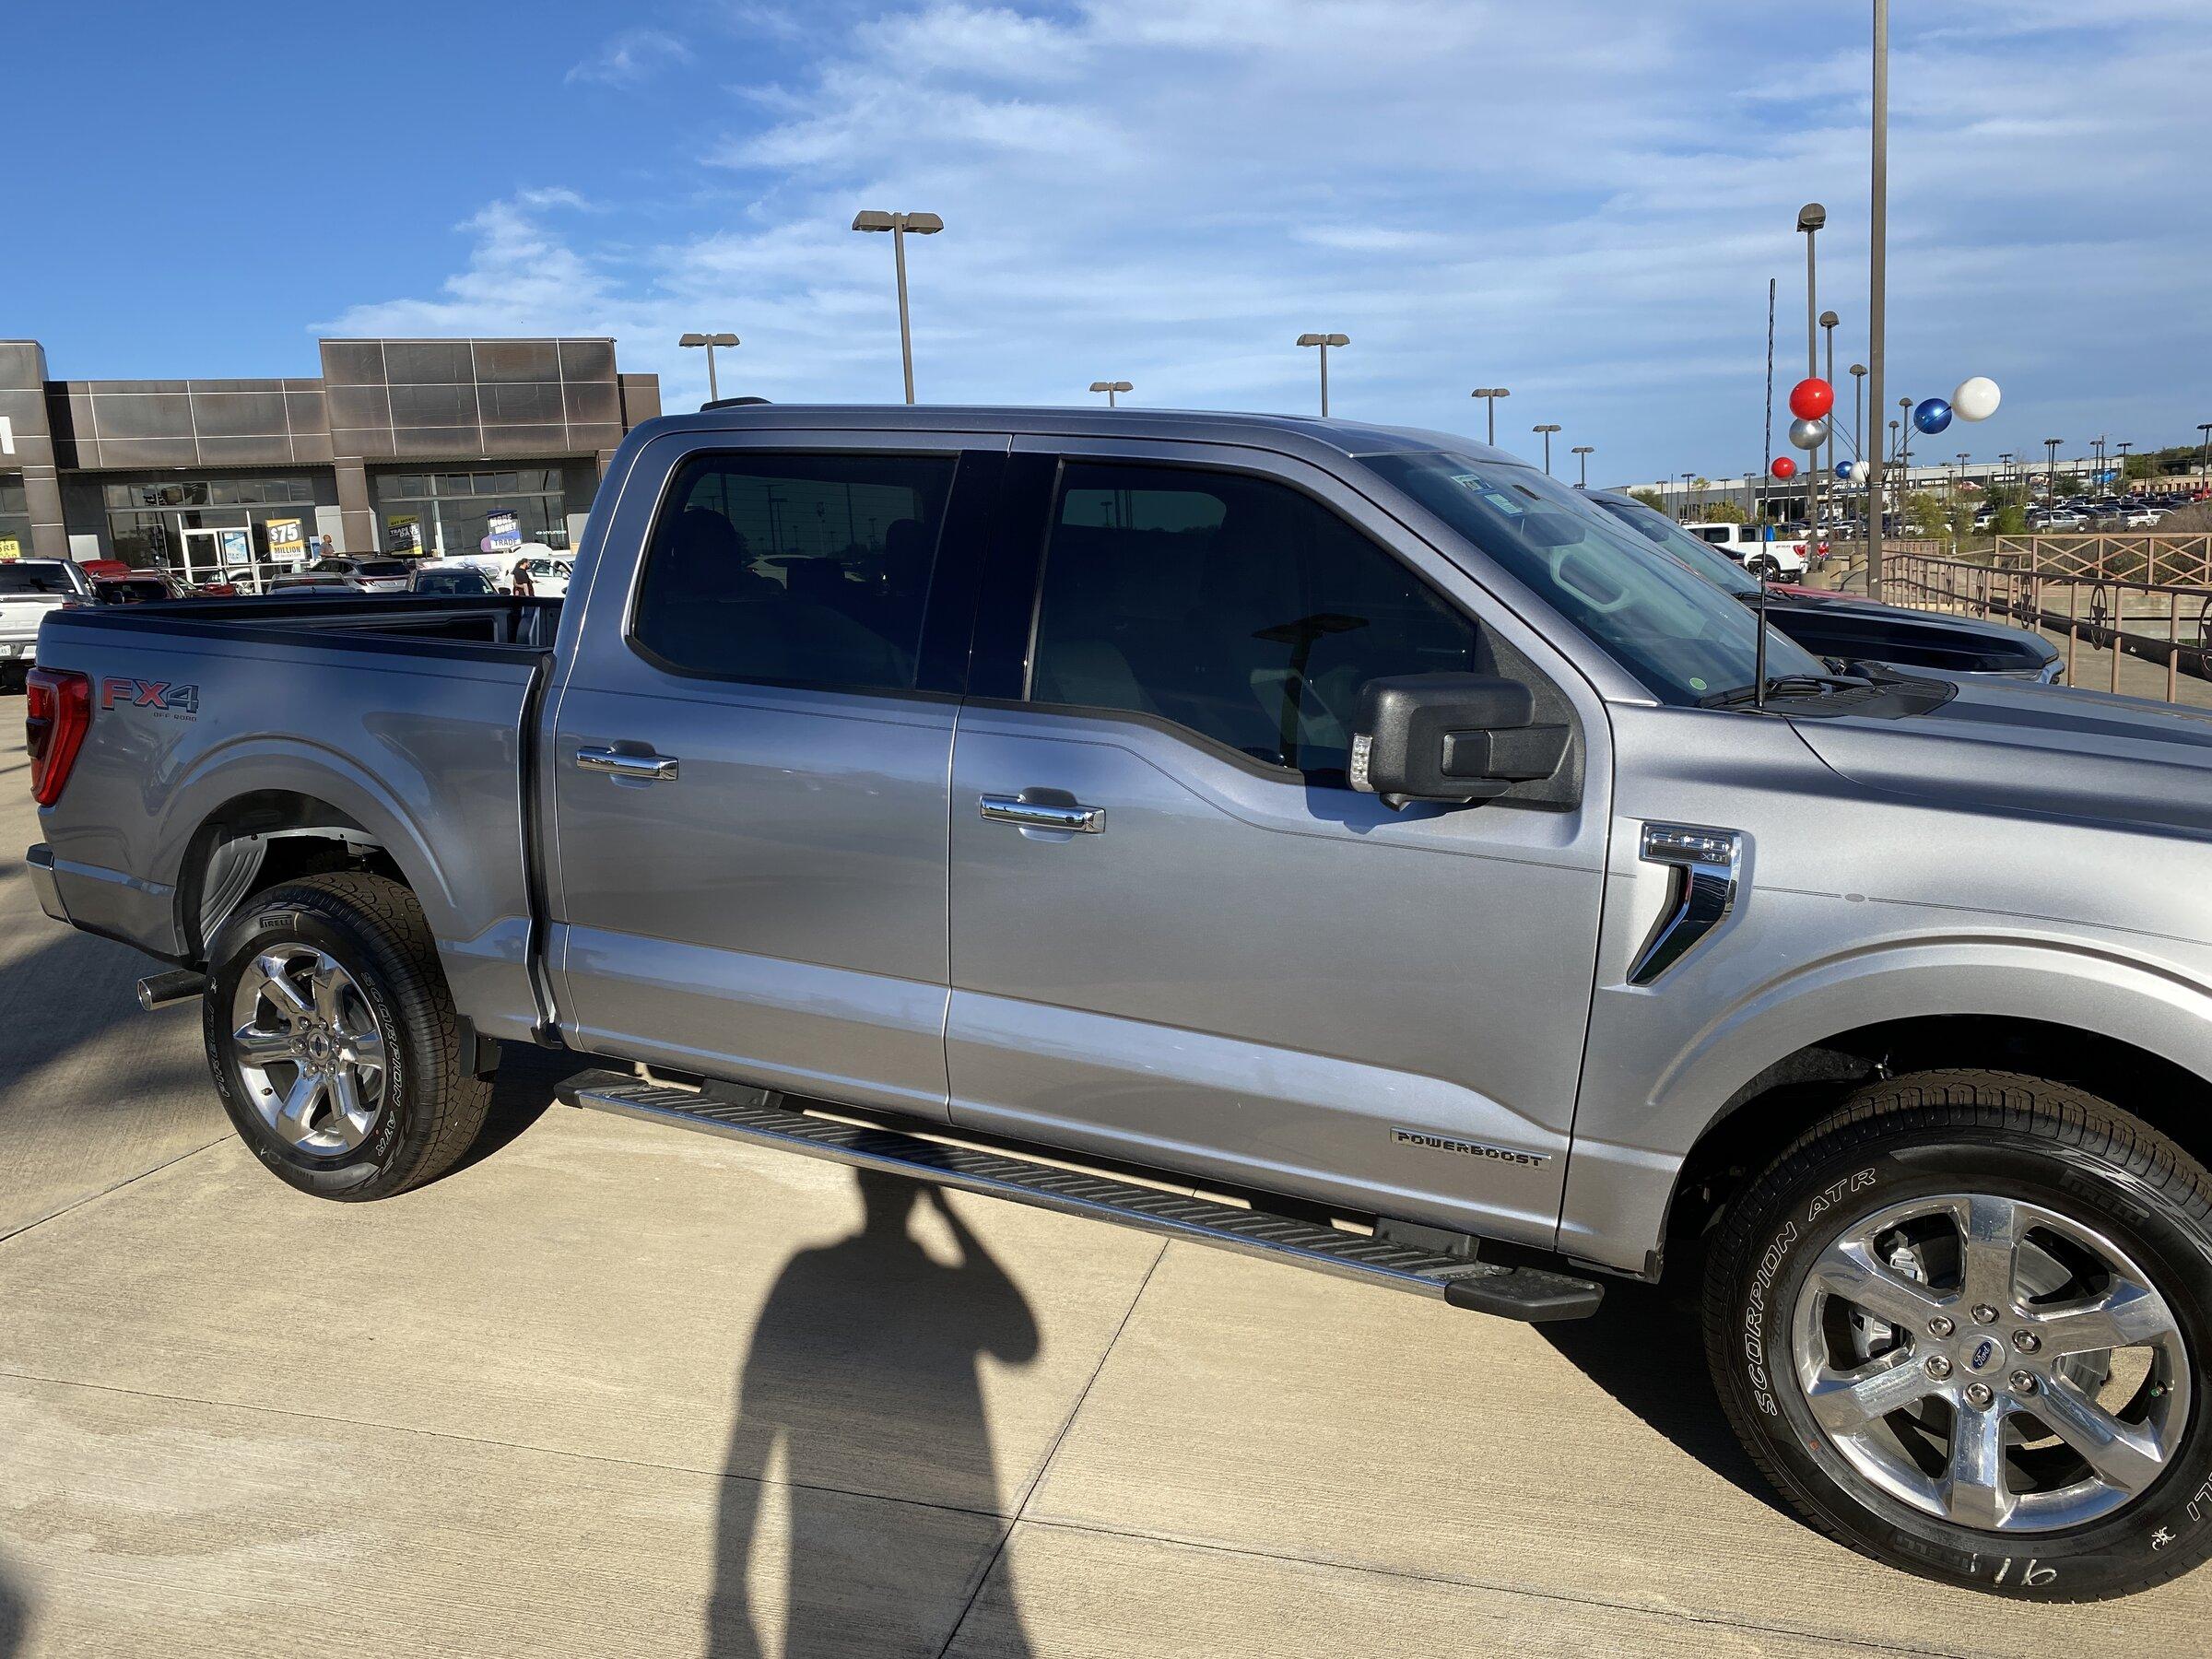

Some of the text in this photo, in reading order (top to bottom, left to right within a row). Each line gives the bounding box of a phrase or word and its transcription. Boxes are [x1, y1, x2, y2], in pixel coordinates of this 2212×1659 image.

[489, 513, 512, 527] MORE
[495, 522, 516, 534] MONEY
[270, 524, 298, 543] $75
[274, 546, 300, 554] MILLION
[101, 677, 199, 713] FX4
[260, 915, 292, 928] PIRELLI
[360, 971, 403, 1156] SCORPION ATR
[1397, 1132, 1543, 1167] POWERBOOST
[1745, 1221, 1797, 1416] SCORPION
[1808, 1168, 1876, 1222] ATR
[1973, 1345, 1991, 1366] Ford
